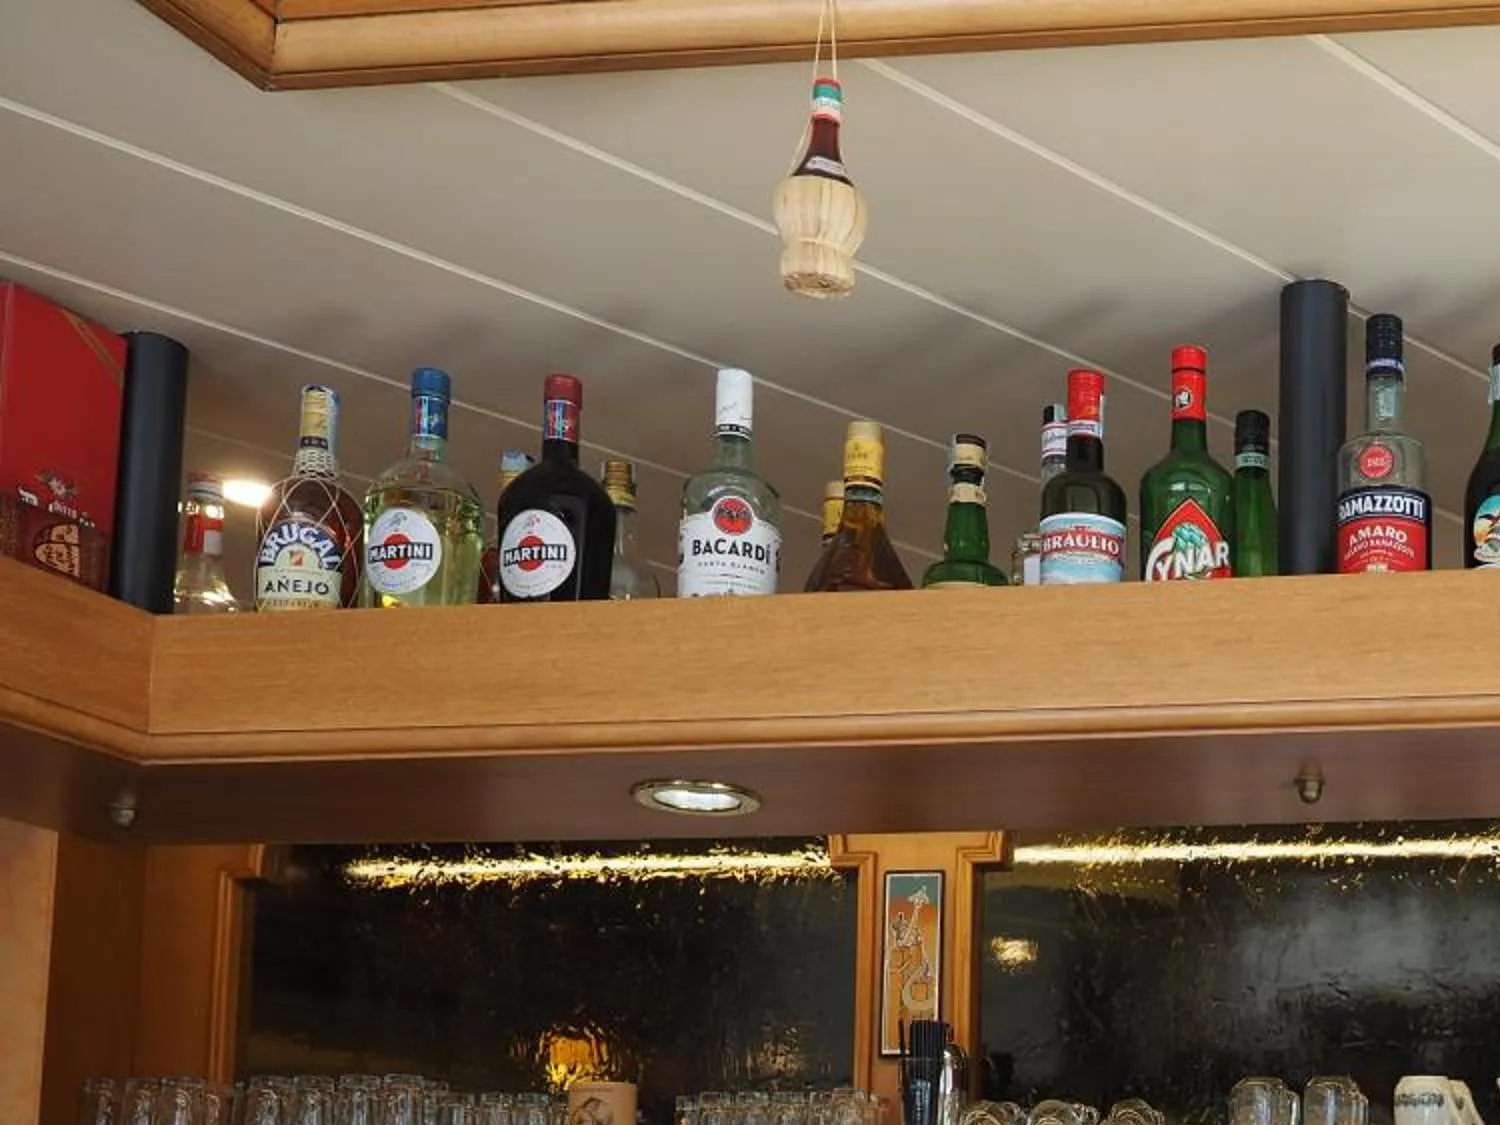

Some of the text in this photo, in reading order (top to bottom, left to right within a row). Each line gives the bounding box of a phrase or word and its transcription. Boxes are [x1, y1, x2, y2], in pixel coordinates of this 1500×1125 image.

[257, 522, 342, 571] BRUGAL
[1043, 532, 1120, 555] BRAULIO
[1349, 525, 1408, 548] AMARO
[368, 544, 433, 562] MARTINI
[504, 546, 566, 566] MARTINI
[1145, 536, 1230, 581] CYNAR
[264, 575, 330, 596] AÑEJO
